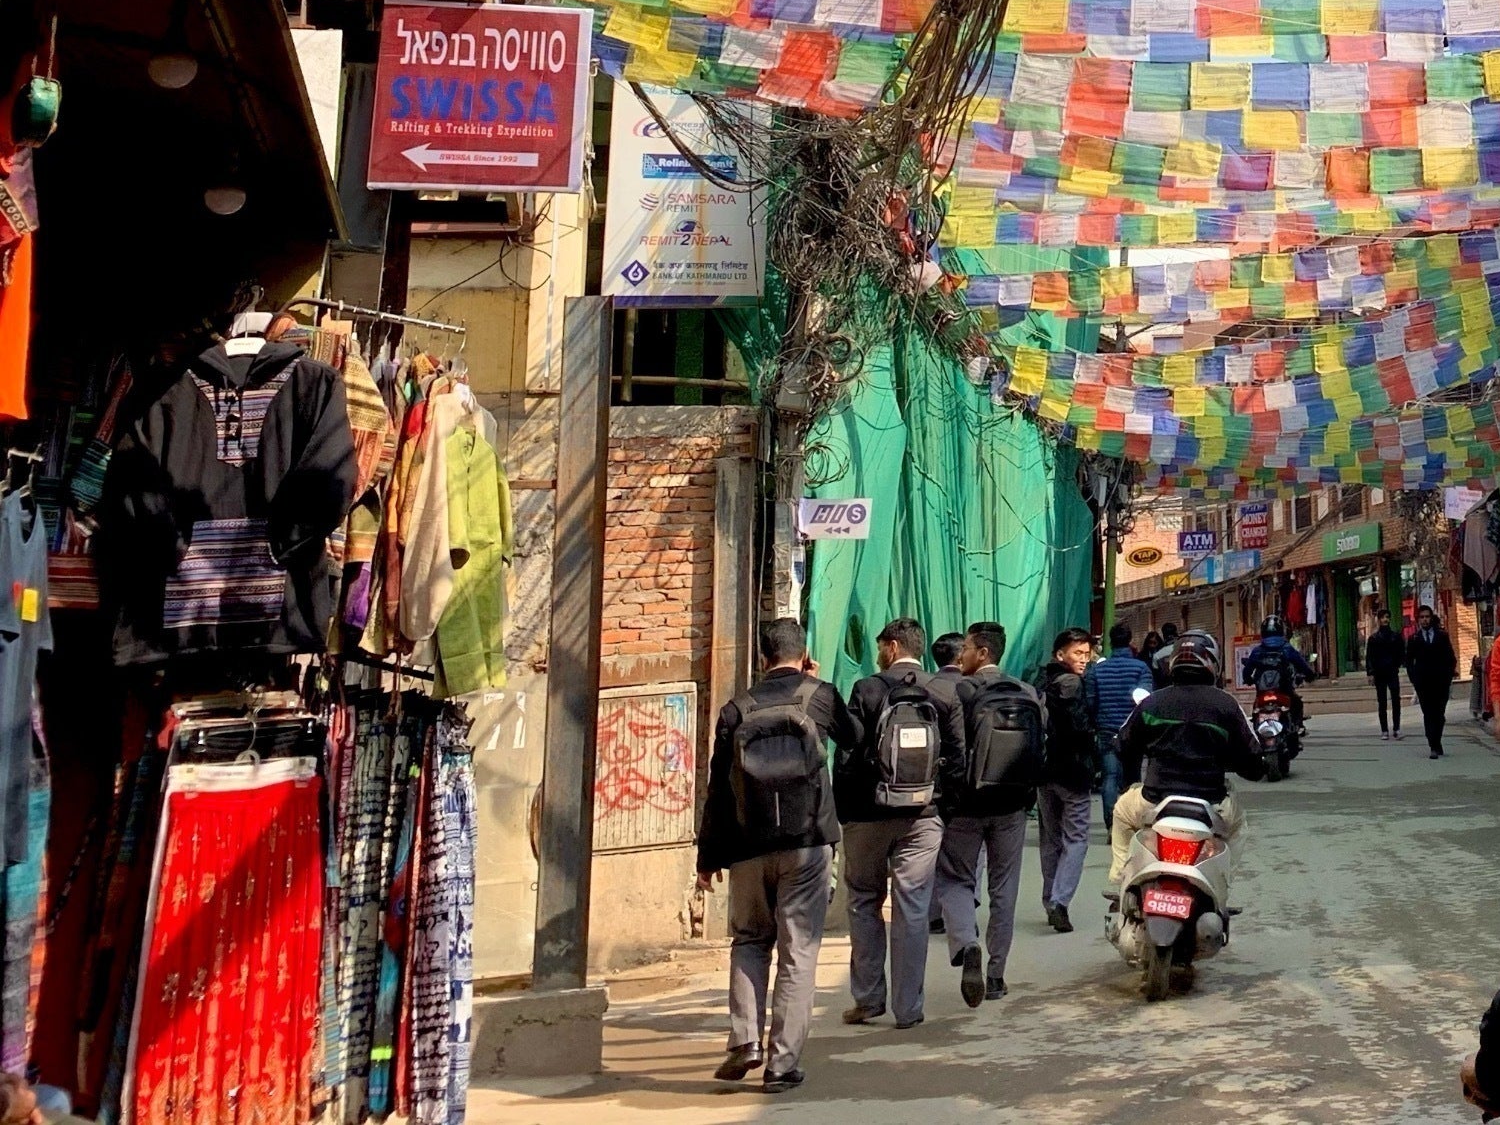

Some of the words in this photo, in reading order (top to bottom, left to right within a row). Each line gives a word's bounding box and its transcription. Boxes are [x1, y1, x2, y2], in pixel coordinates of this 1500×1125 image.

[396, 18, 477, 67] בנפאל
[481, 27, 567, 74] סוויסה
[390, 76, 557, 124] SWISSA
[390, 121, 430, 136] Rafting
[434, 124, 442, 134] &
[446, 124, 493, 138] Trekking
[496, 124, 554, 139] Expedition
[438, 153, 471, 162] SWISSA
[473, 154, 495, 163] Since
[668, 193, 737, 205] SAMSARA
[666, 204, 700, 213] REMIT
[685, 272, 732, 281] KATHMANDU
[734, 272, 748, 280] LTD
[810, 503, 867, 524] HIS
[1242, 512, 1267, 525] MONEY
[1183, 534, 1214, 546] ATM
